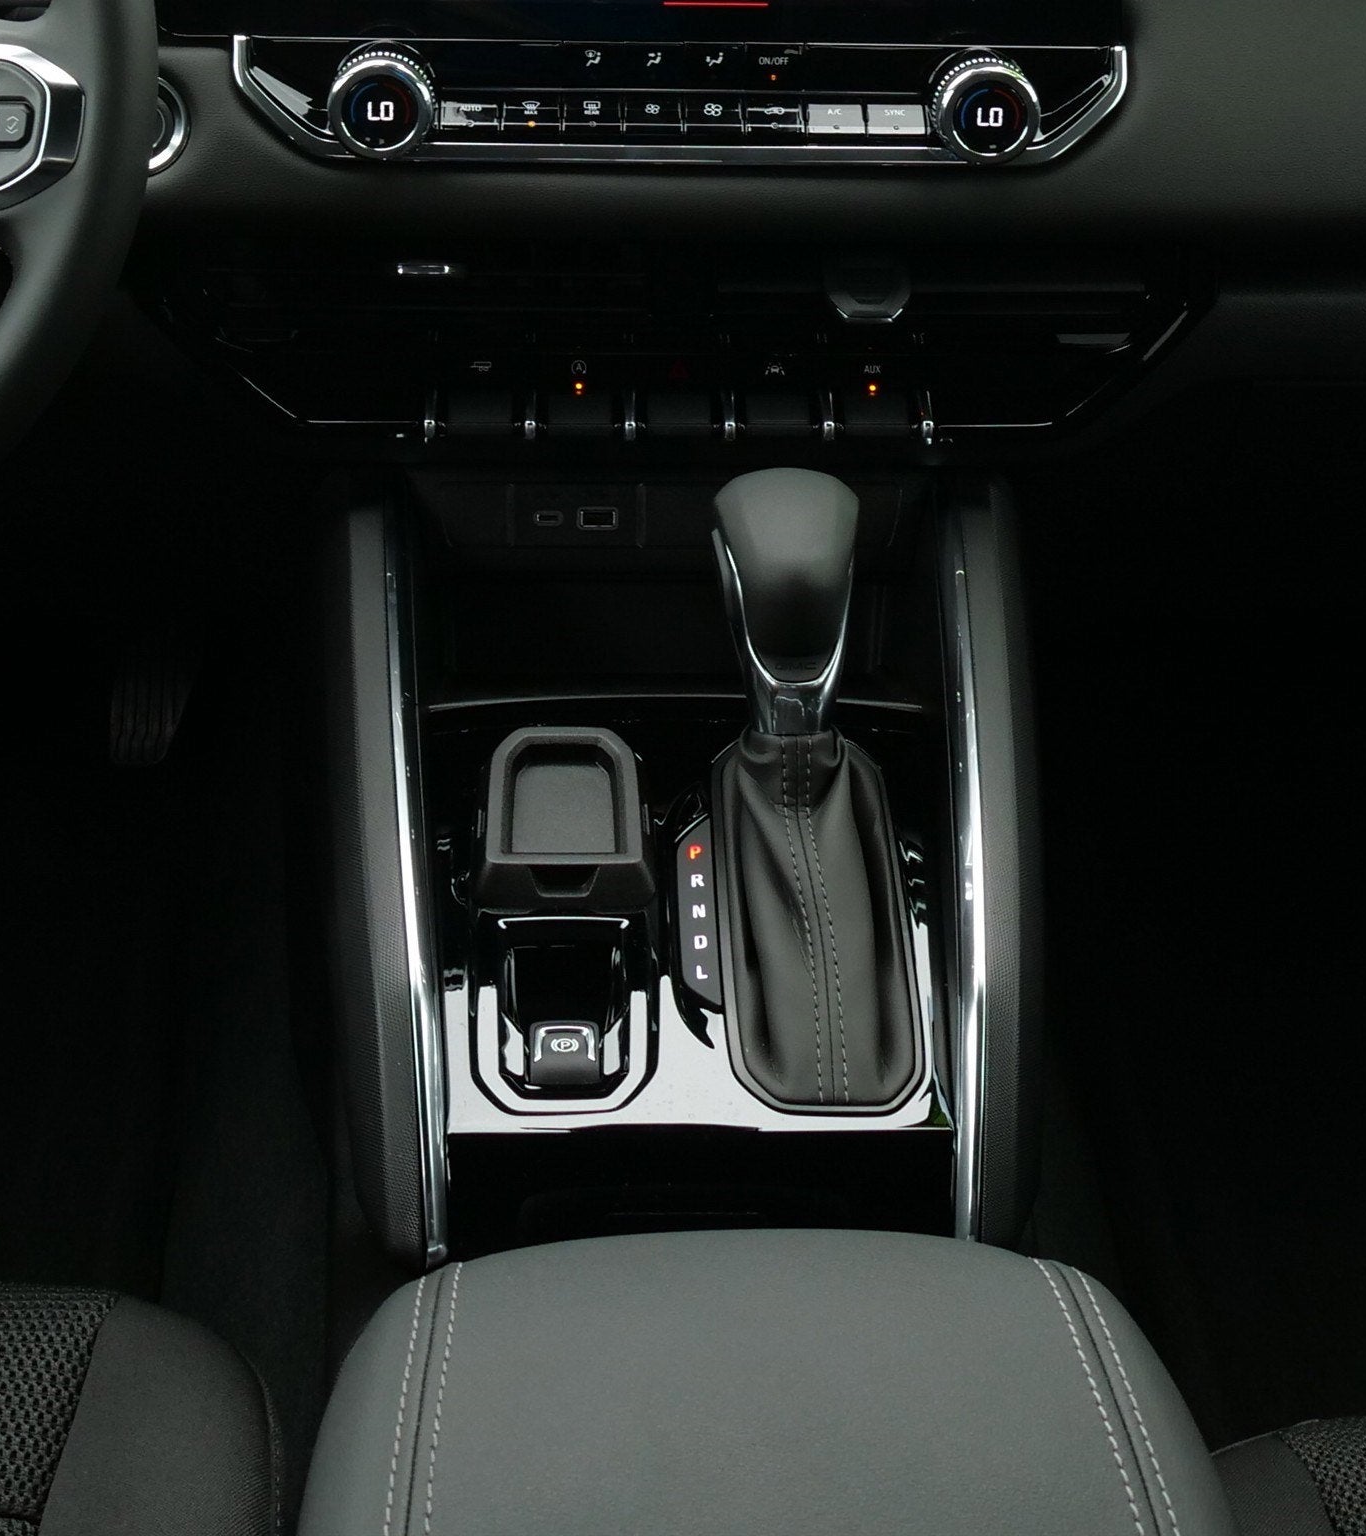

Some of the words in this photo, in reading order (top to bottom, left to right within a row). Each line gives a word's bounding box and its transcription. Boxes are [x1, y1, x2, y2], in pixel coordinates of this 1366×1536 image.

[759, 57, 789, 65] ON/OFF
[367, 101, 394, 121] LO
[977, 107, 1003, 127] LO
[864, 365, 881, 373] AUX
[689, 845, 702, 859] P
[690, 873, 705, 888] R
[692, 904, 706, 919] N
[694, 934, 708, 950] D
[695, 964, 709, 980] L
